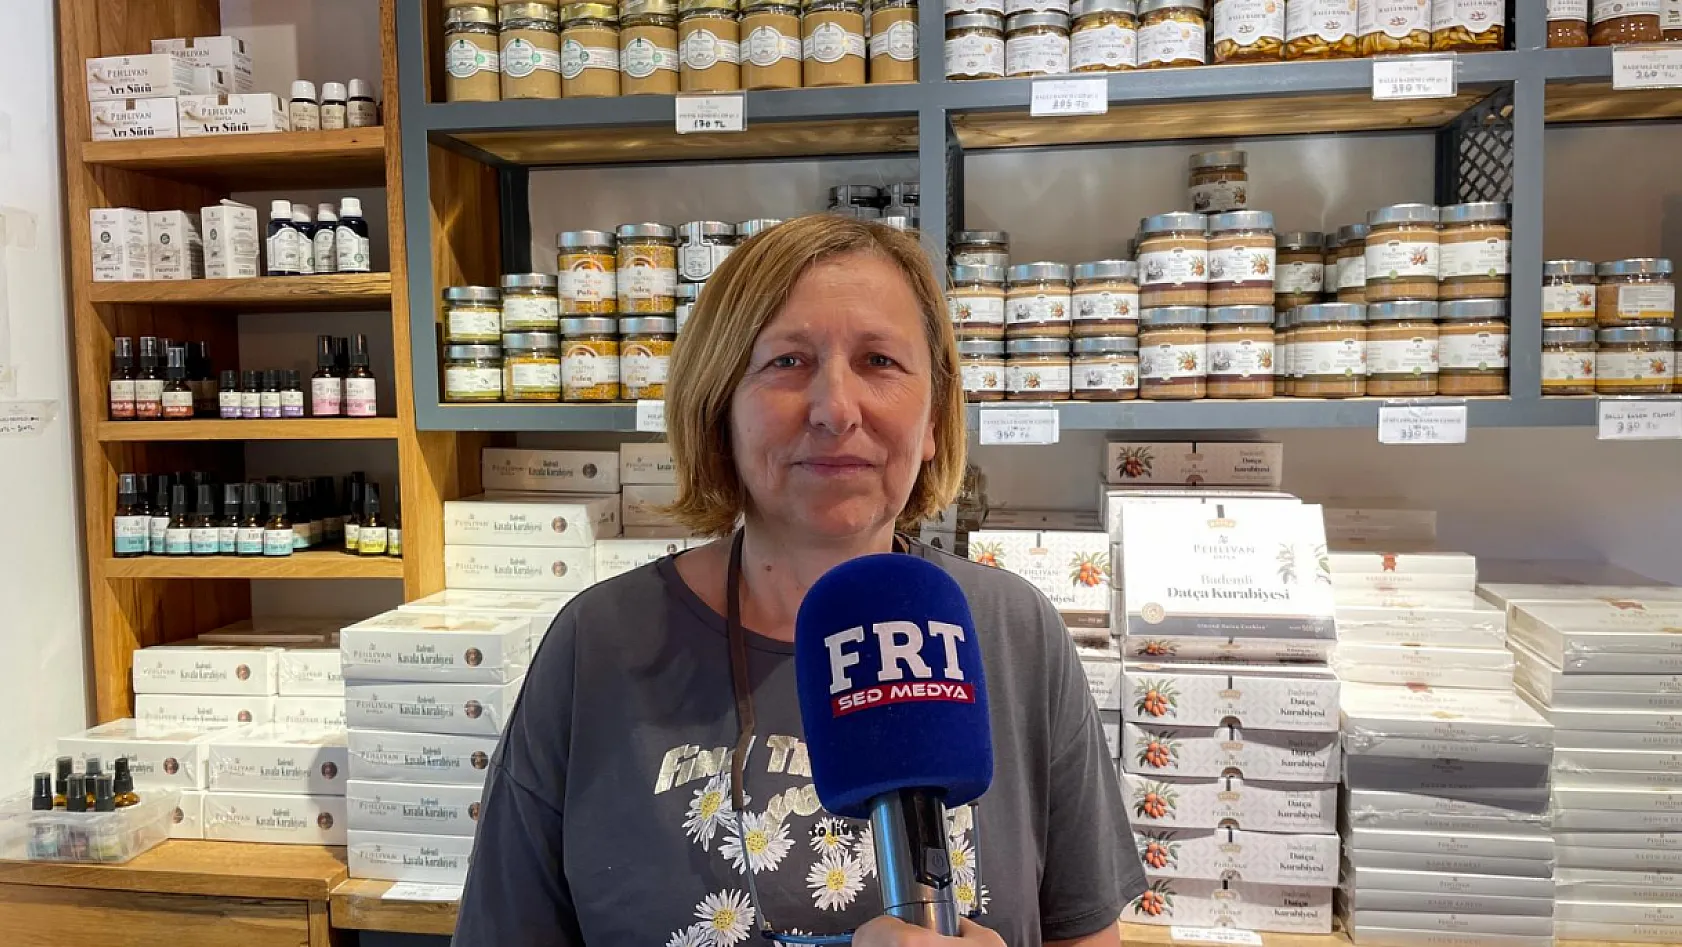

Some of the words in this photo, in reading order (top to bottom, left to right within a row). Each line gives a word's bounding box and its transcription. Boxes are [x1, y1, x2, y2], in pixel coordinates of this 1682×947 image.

[107, 68, 148, 78] PEHLIVAN
[126, 82, 152, 94] Sütü
[111, 112, 152, 121] PEHLIVAN
[201, 107, 247, 117] PEHLIVAN
[129, 126, 155, 137] Sütü
[222, 121, 249, 132] Sütü
[1194, 543, 1255, 556] PEHLIVAN
[1201, 574, 1254, 587] Bademli
[1166, 587, 1210, 602] Datça
[1211, 587, 1291, 604] Kurabiyesi
[824, 621, 966, 694] FRT
[838, 688, 883, 711] SED
[890, 683, 969, 700] MEDYA
